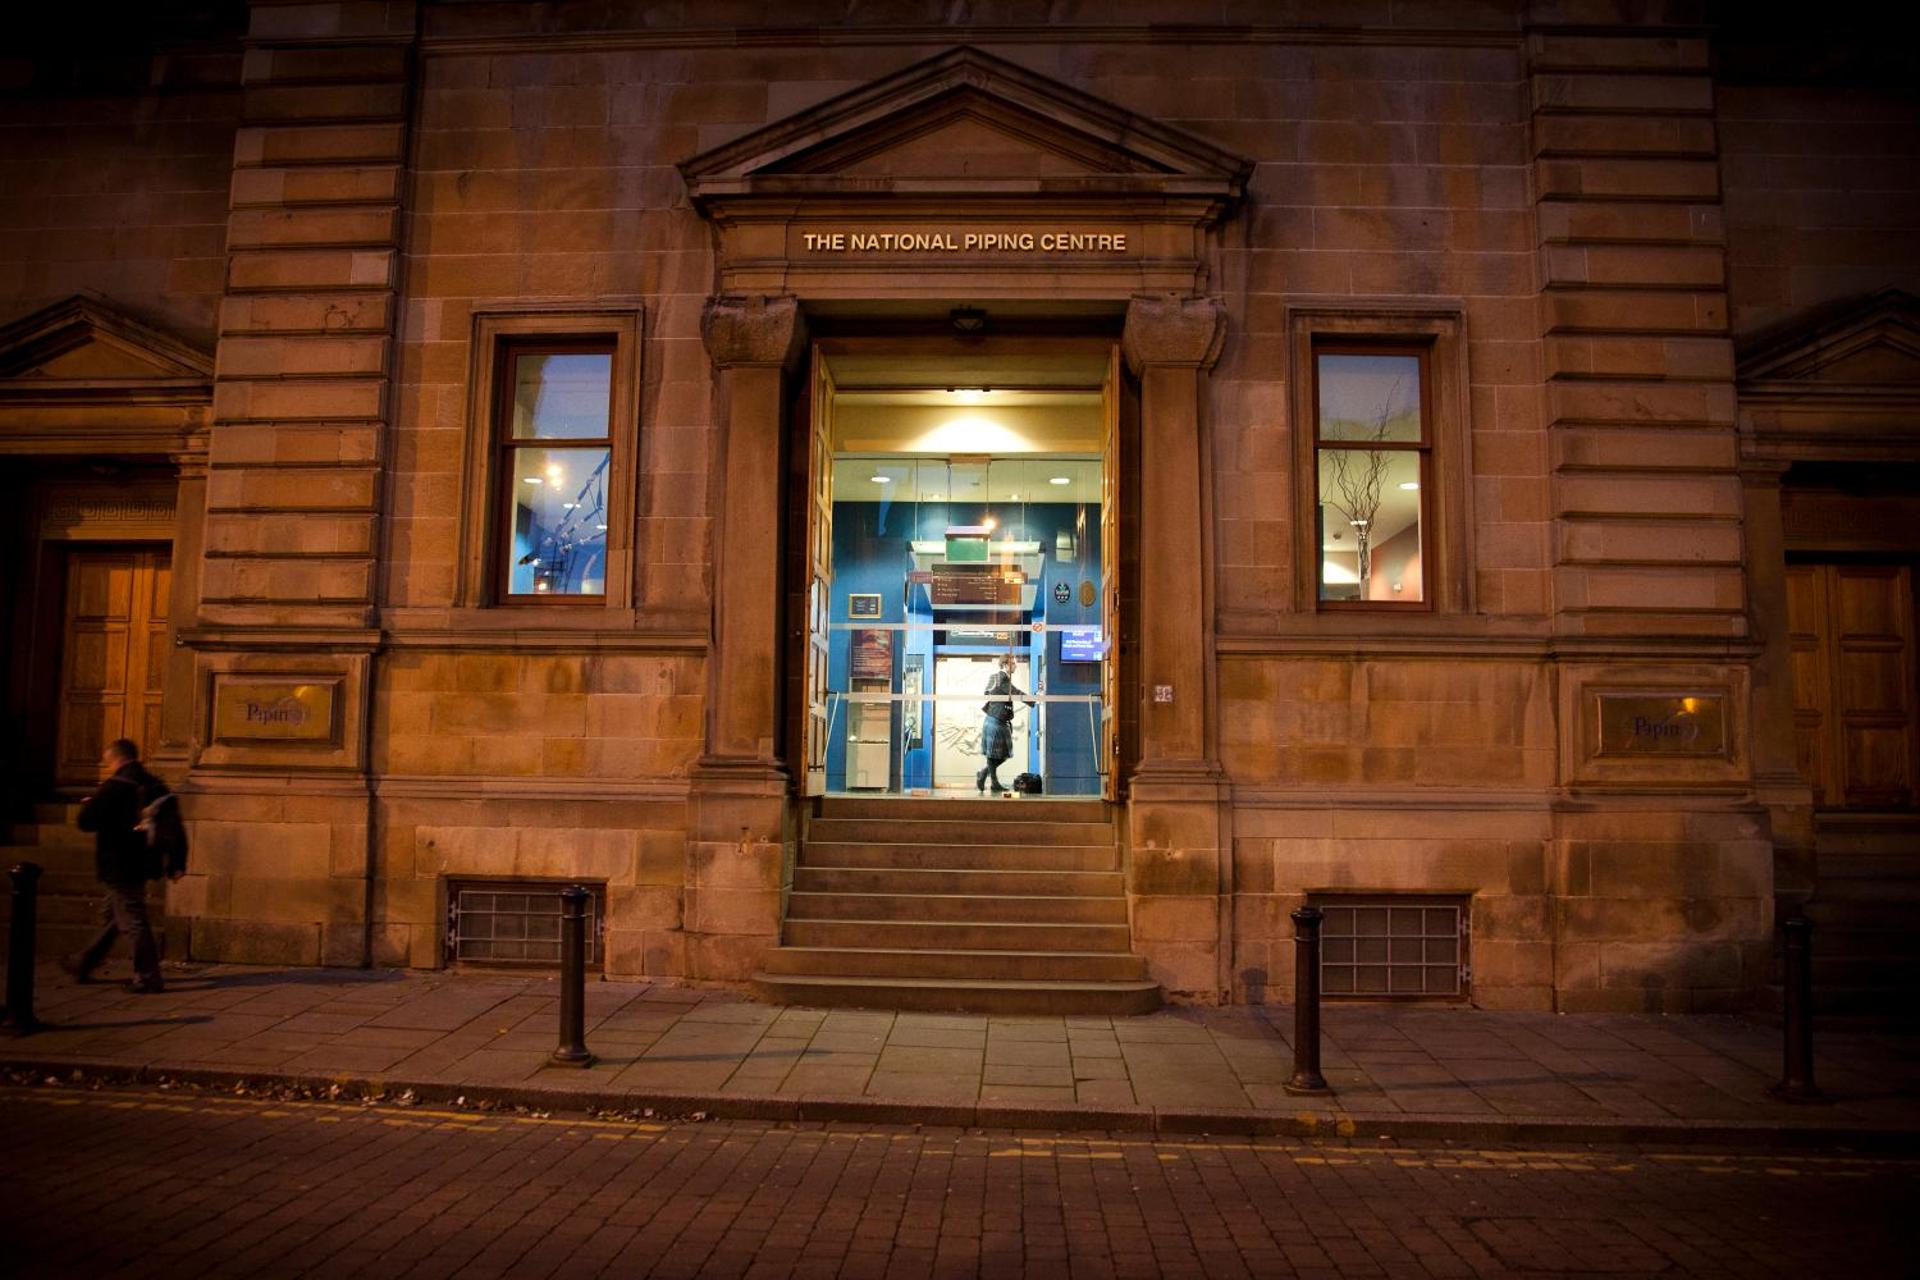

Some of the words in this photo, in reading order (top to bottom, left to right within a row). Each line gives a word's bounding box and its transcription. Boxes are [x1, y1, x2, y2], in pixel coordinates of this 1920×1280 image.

[803, 233, 845, 251] THE
[850, 233, 958, 251] NATIONAL
[964, 233, 1034, 251] PIPING
[1040, 233, 1127, 251] CENTRE
